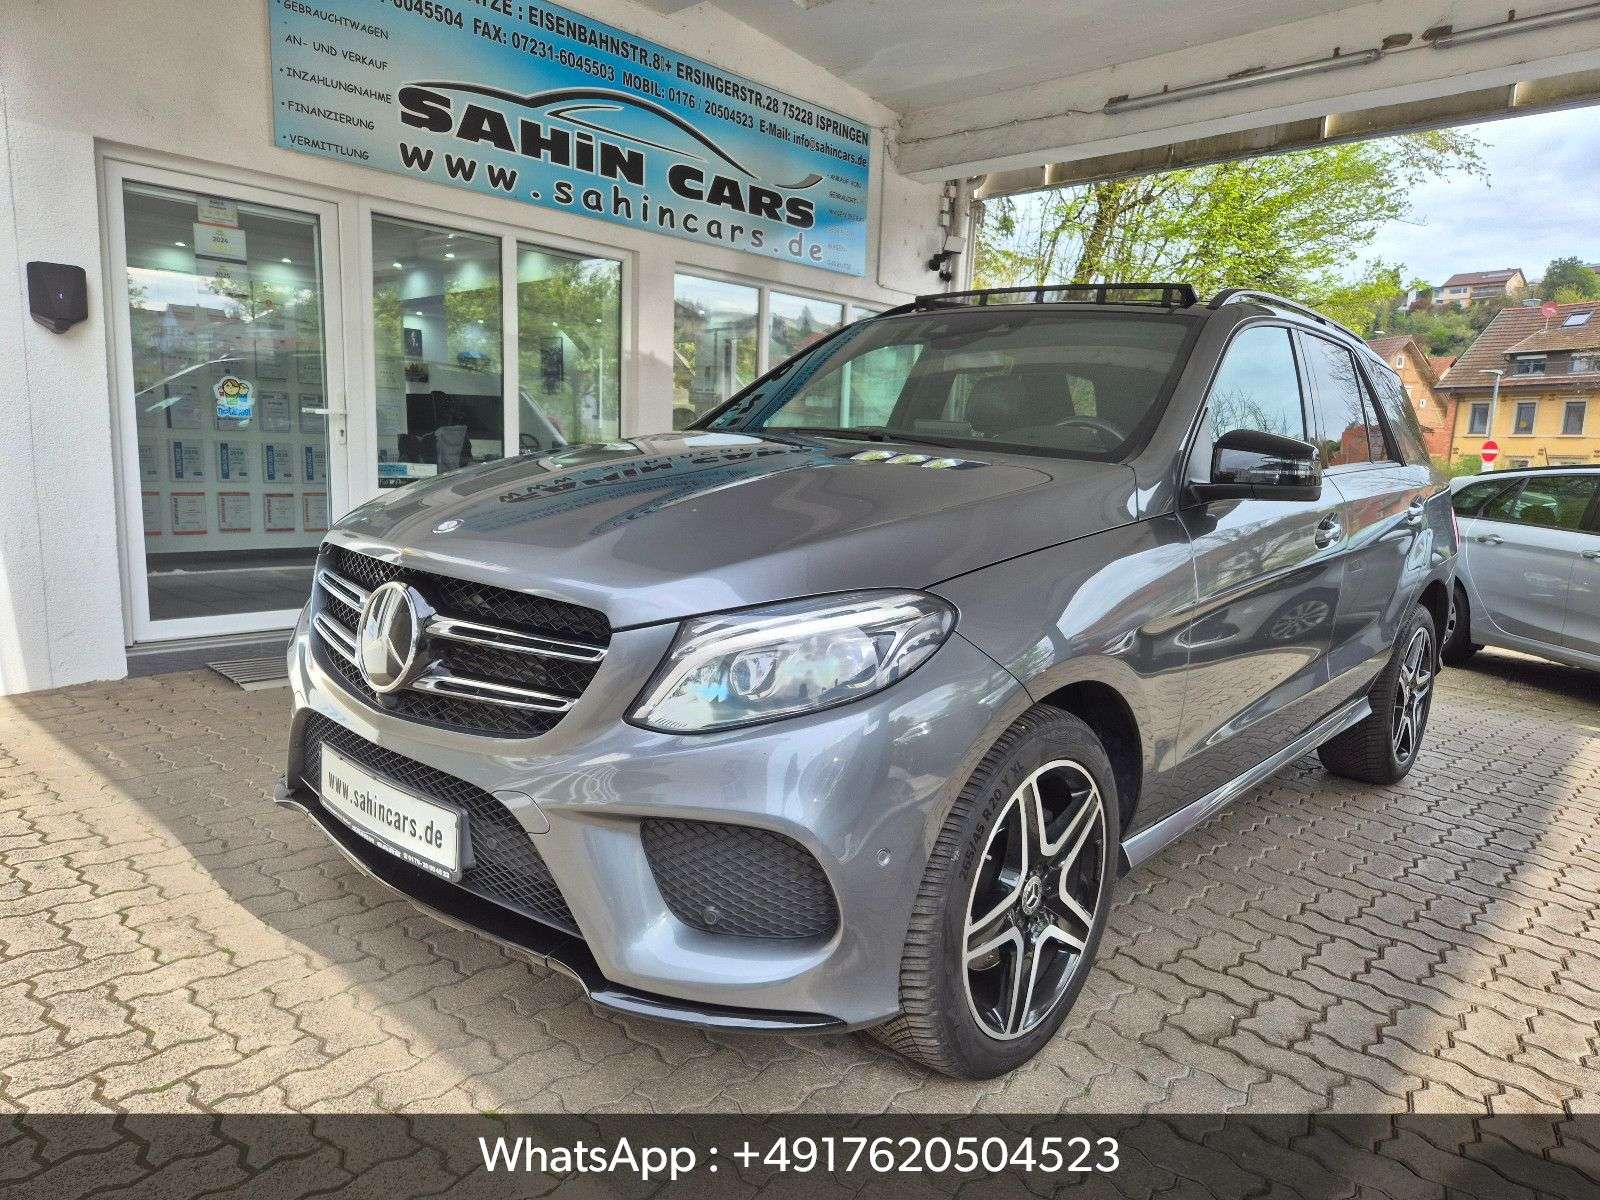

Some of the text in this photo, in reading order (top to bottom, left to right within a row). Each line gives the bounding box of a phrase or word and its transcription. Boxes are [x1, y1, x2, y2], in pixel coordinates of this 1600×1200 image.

[283, 0, 389, 40] GEBRAUCHTWAGEN
[285, 34, 388, 71] AN- UND VERKAUF
[286, 66, 392, 104] INZAHLUNGNAHME
[473, 17, 507, 44] FAX:
[511, 32, 615, 82] 07231-6045503
[623, 71, 665, 99] MOBIL:
[668, 87, 695, 109] 0176
[704, 100, 754, 129] 20504523
[759, 119, 791, 141] E-Mail:
[793, 131, 867, 168] info@sahincars.de
[676, 62, 779, 114] ERSINGERSTR.28
[782, 101, 813, 126] 75228
[815, 114, 869, 146] ISPRINGEN
[287, 100, 375, 131] FINANZIERUNG
[289, 133, 370, 161] VERMITTLUNG
[667, 163, 815, 230] CARS
[328, 771, 443, 849] www.sahincars.de
